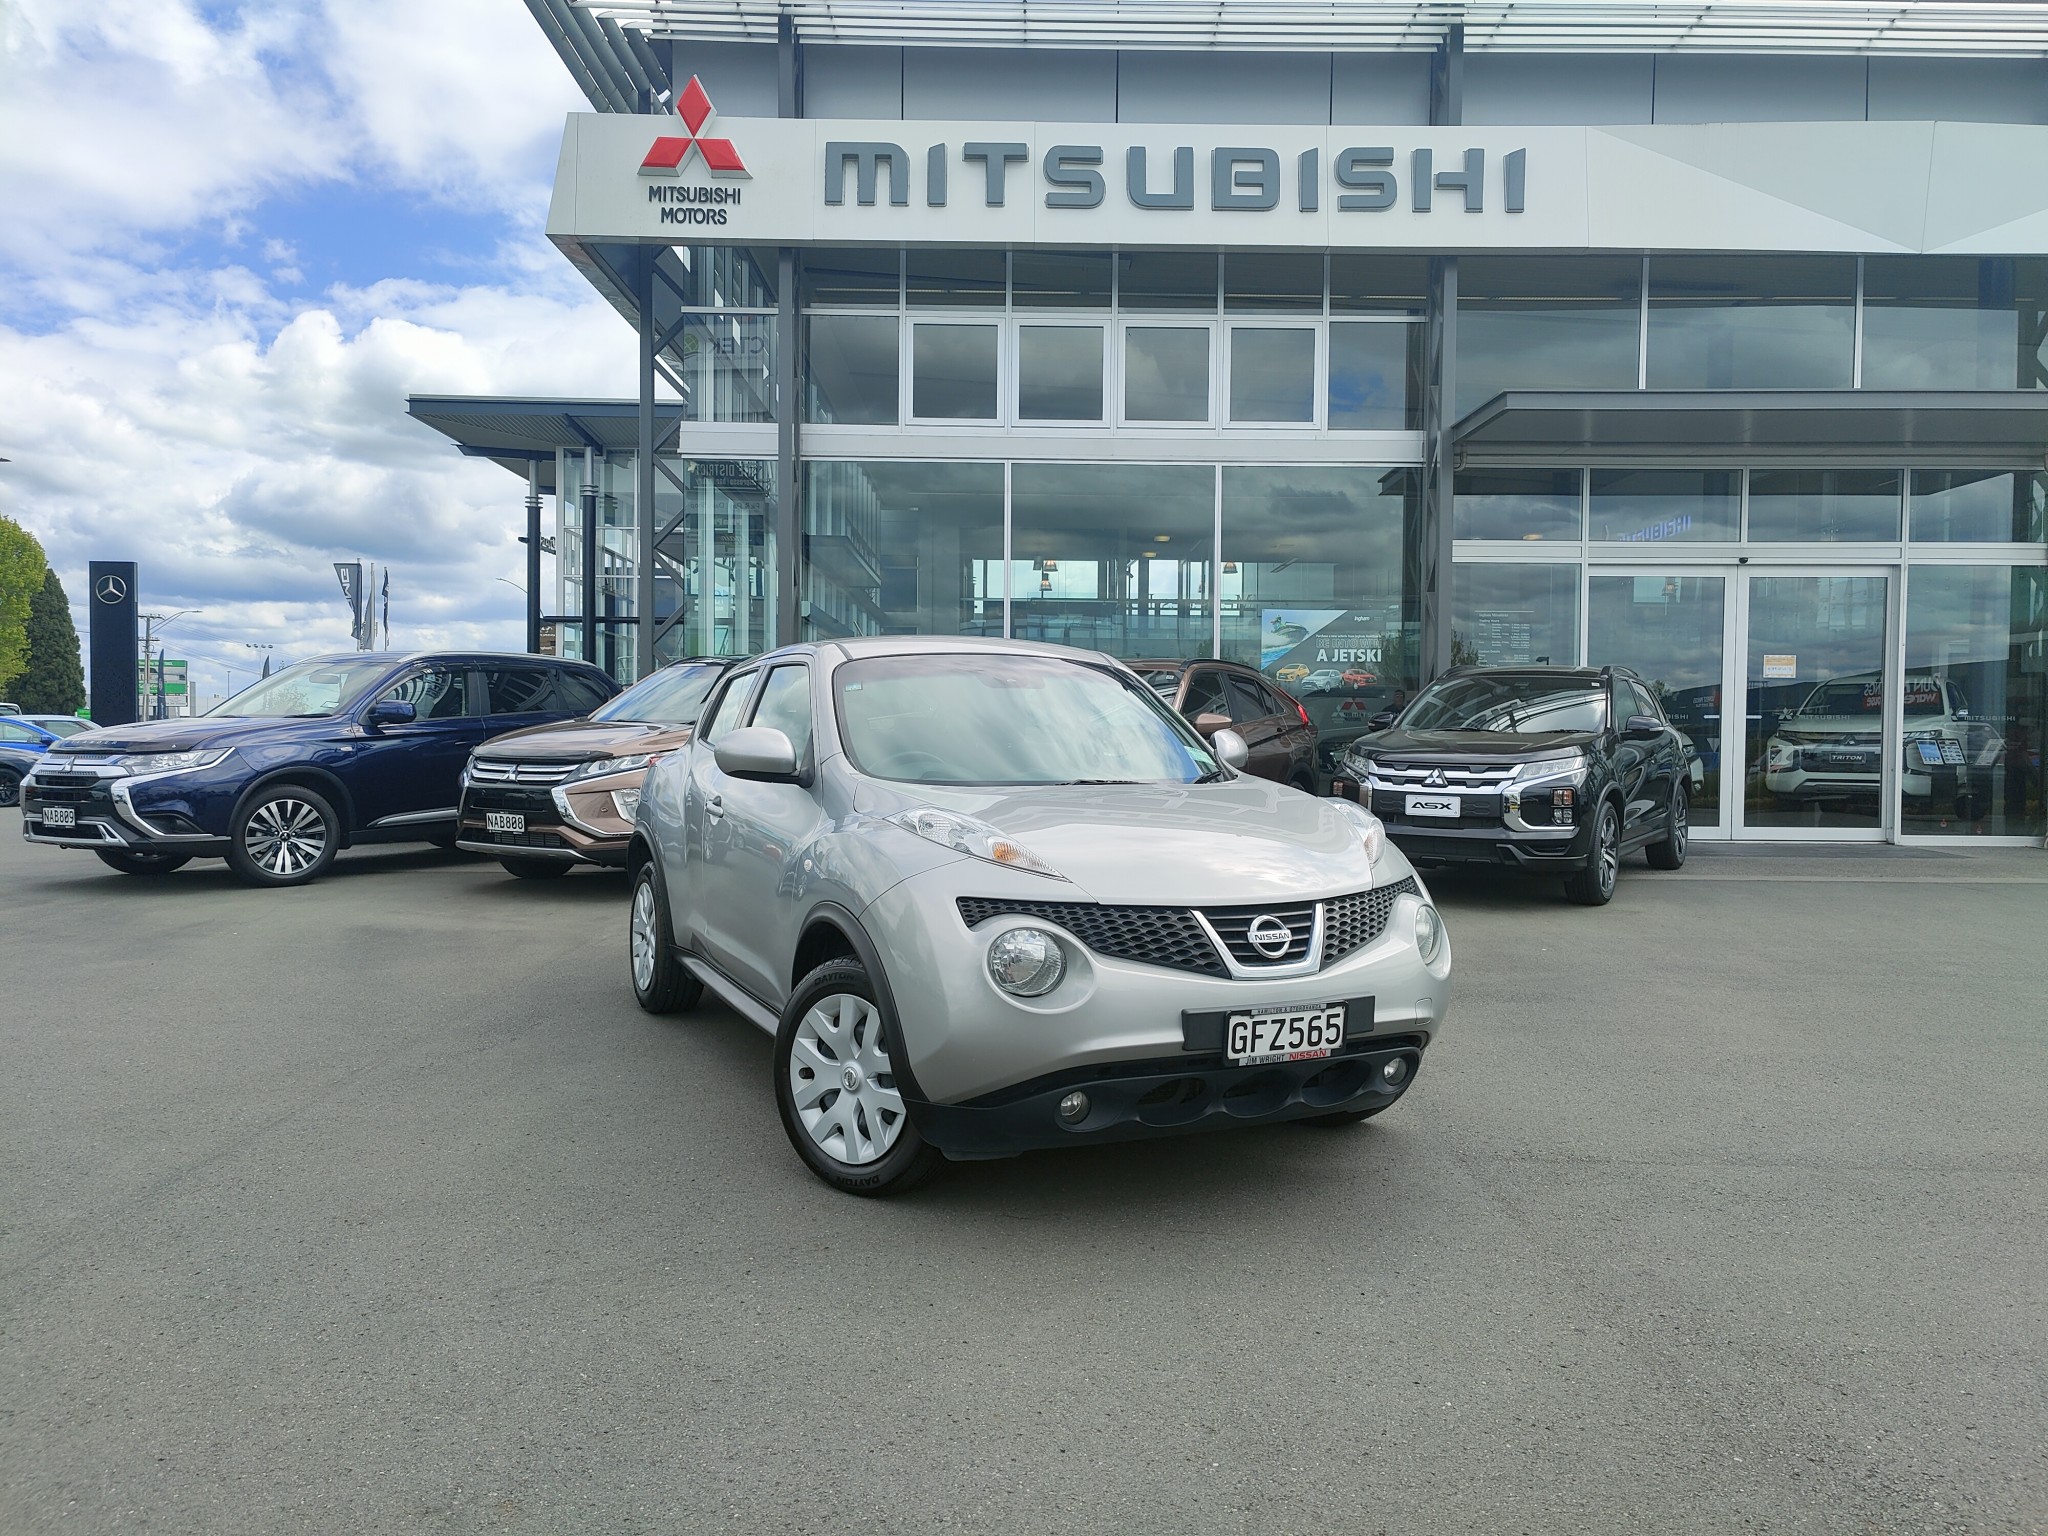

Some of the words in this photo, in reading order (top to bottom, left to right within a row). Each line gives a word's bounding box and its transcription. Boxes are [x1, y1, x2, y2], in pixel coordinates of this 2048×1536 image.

[824, 141, 1527, 214] MITSUBISHI
[648, 185, 741, 205] MITSUBISHI
[660, 206, 728, 225] MOTORS
[1316, 649, 1328, 662] A
[1332, 649, 1382, 662] JETSKI
[1411, 801, 1453, 811] ASX
[1254, 932, 1290, 940] NISSAN
[1231, 1013, 1341, 1055] GFZ565
[1245, 1056, 1258, 1065] JIM
[1260, 1054, 1285, 1064] WRIGHT
[1289, 1050, 1327, 1061] NISSAN
